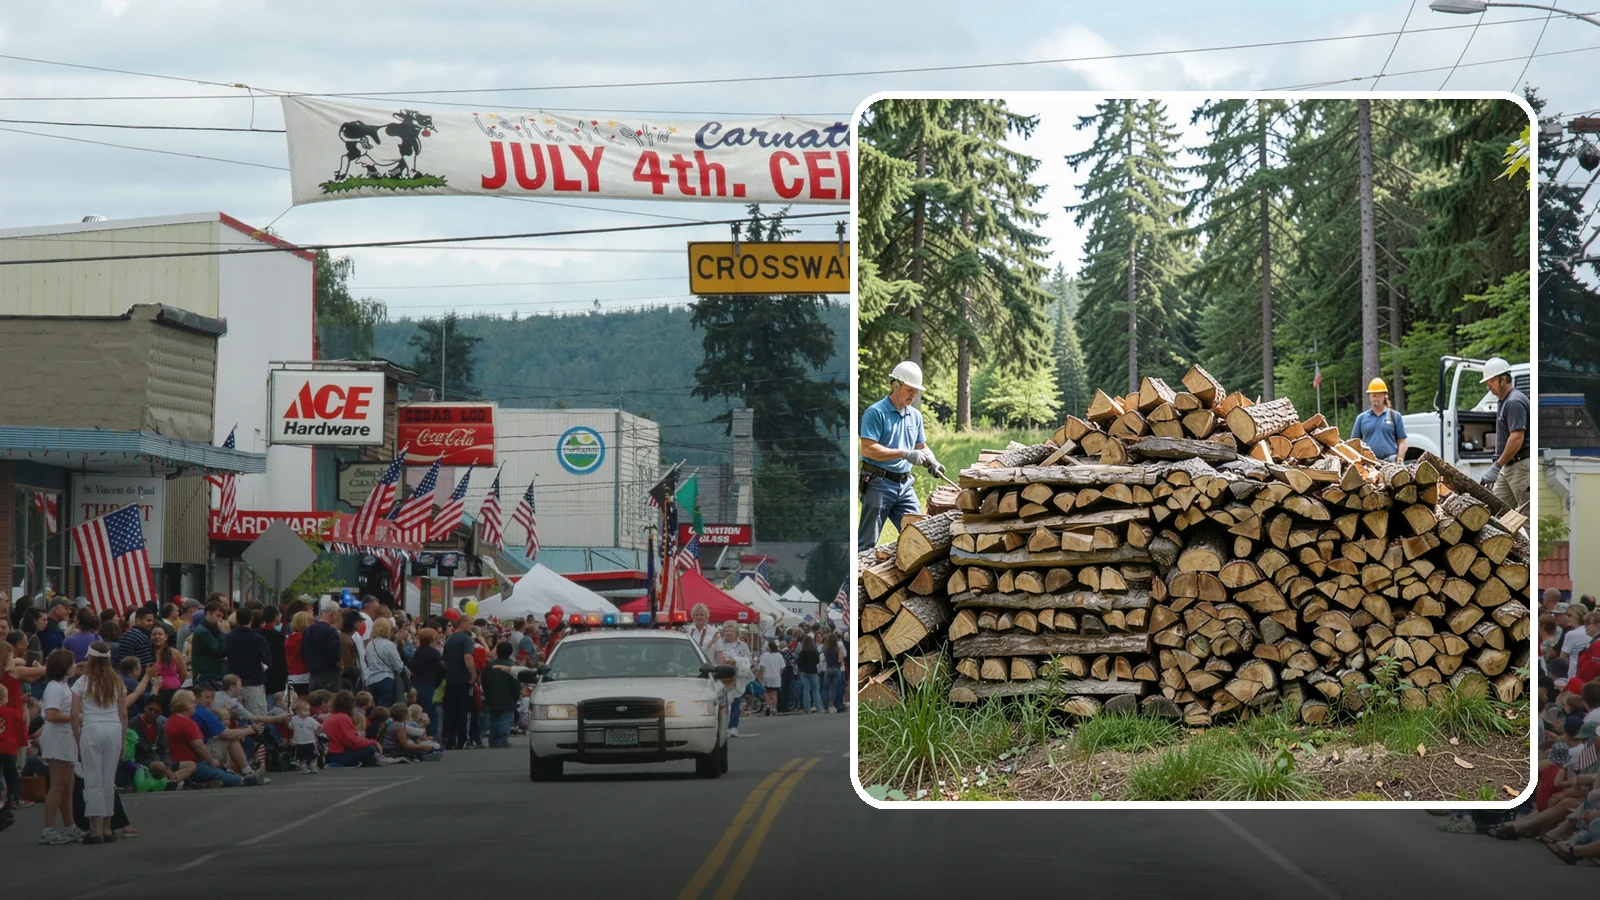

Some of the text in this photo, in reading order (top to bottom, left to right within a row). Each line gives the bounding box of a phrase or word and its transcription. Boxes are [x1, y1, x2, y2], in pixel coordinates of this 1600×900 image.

[481, 141, 605, 193] JULY
[632, 150, 746, 197] 4th.
[696, 253, 851, 280] CROSSWA
[283, 380, 374, 420] ACE
[406, 409, 453, 422] CEDAR
[283, 421, 372, 438] Hardware
[416, 428, 478, 447] Coca-Cola
[353, 467, 386, 480] Simpl
[95, 485, 124, 494] Vincent
[126, 486, 135, 494] de
[137, 486, 155, 495] Paul
[687, 525, 741, 535] CRNATION
[698, 534, 731, 544] GLASS
